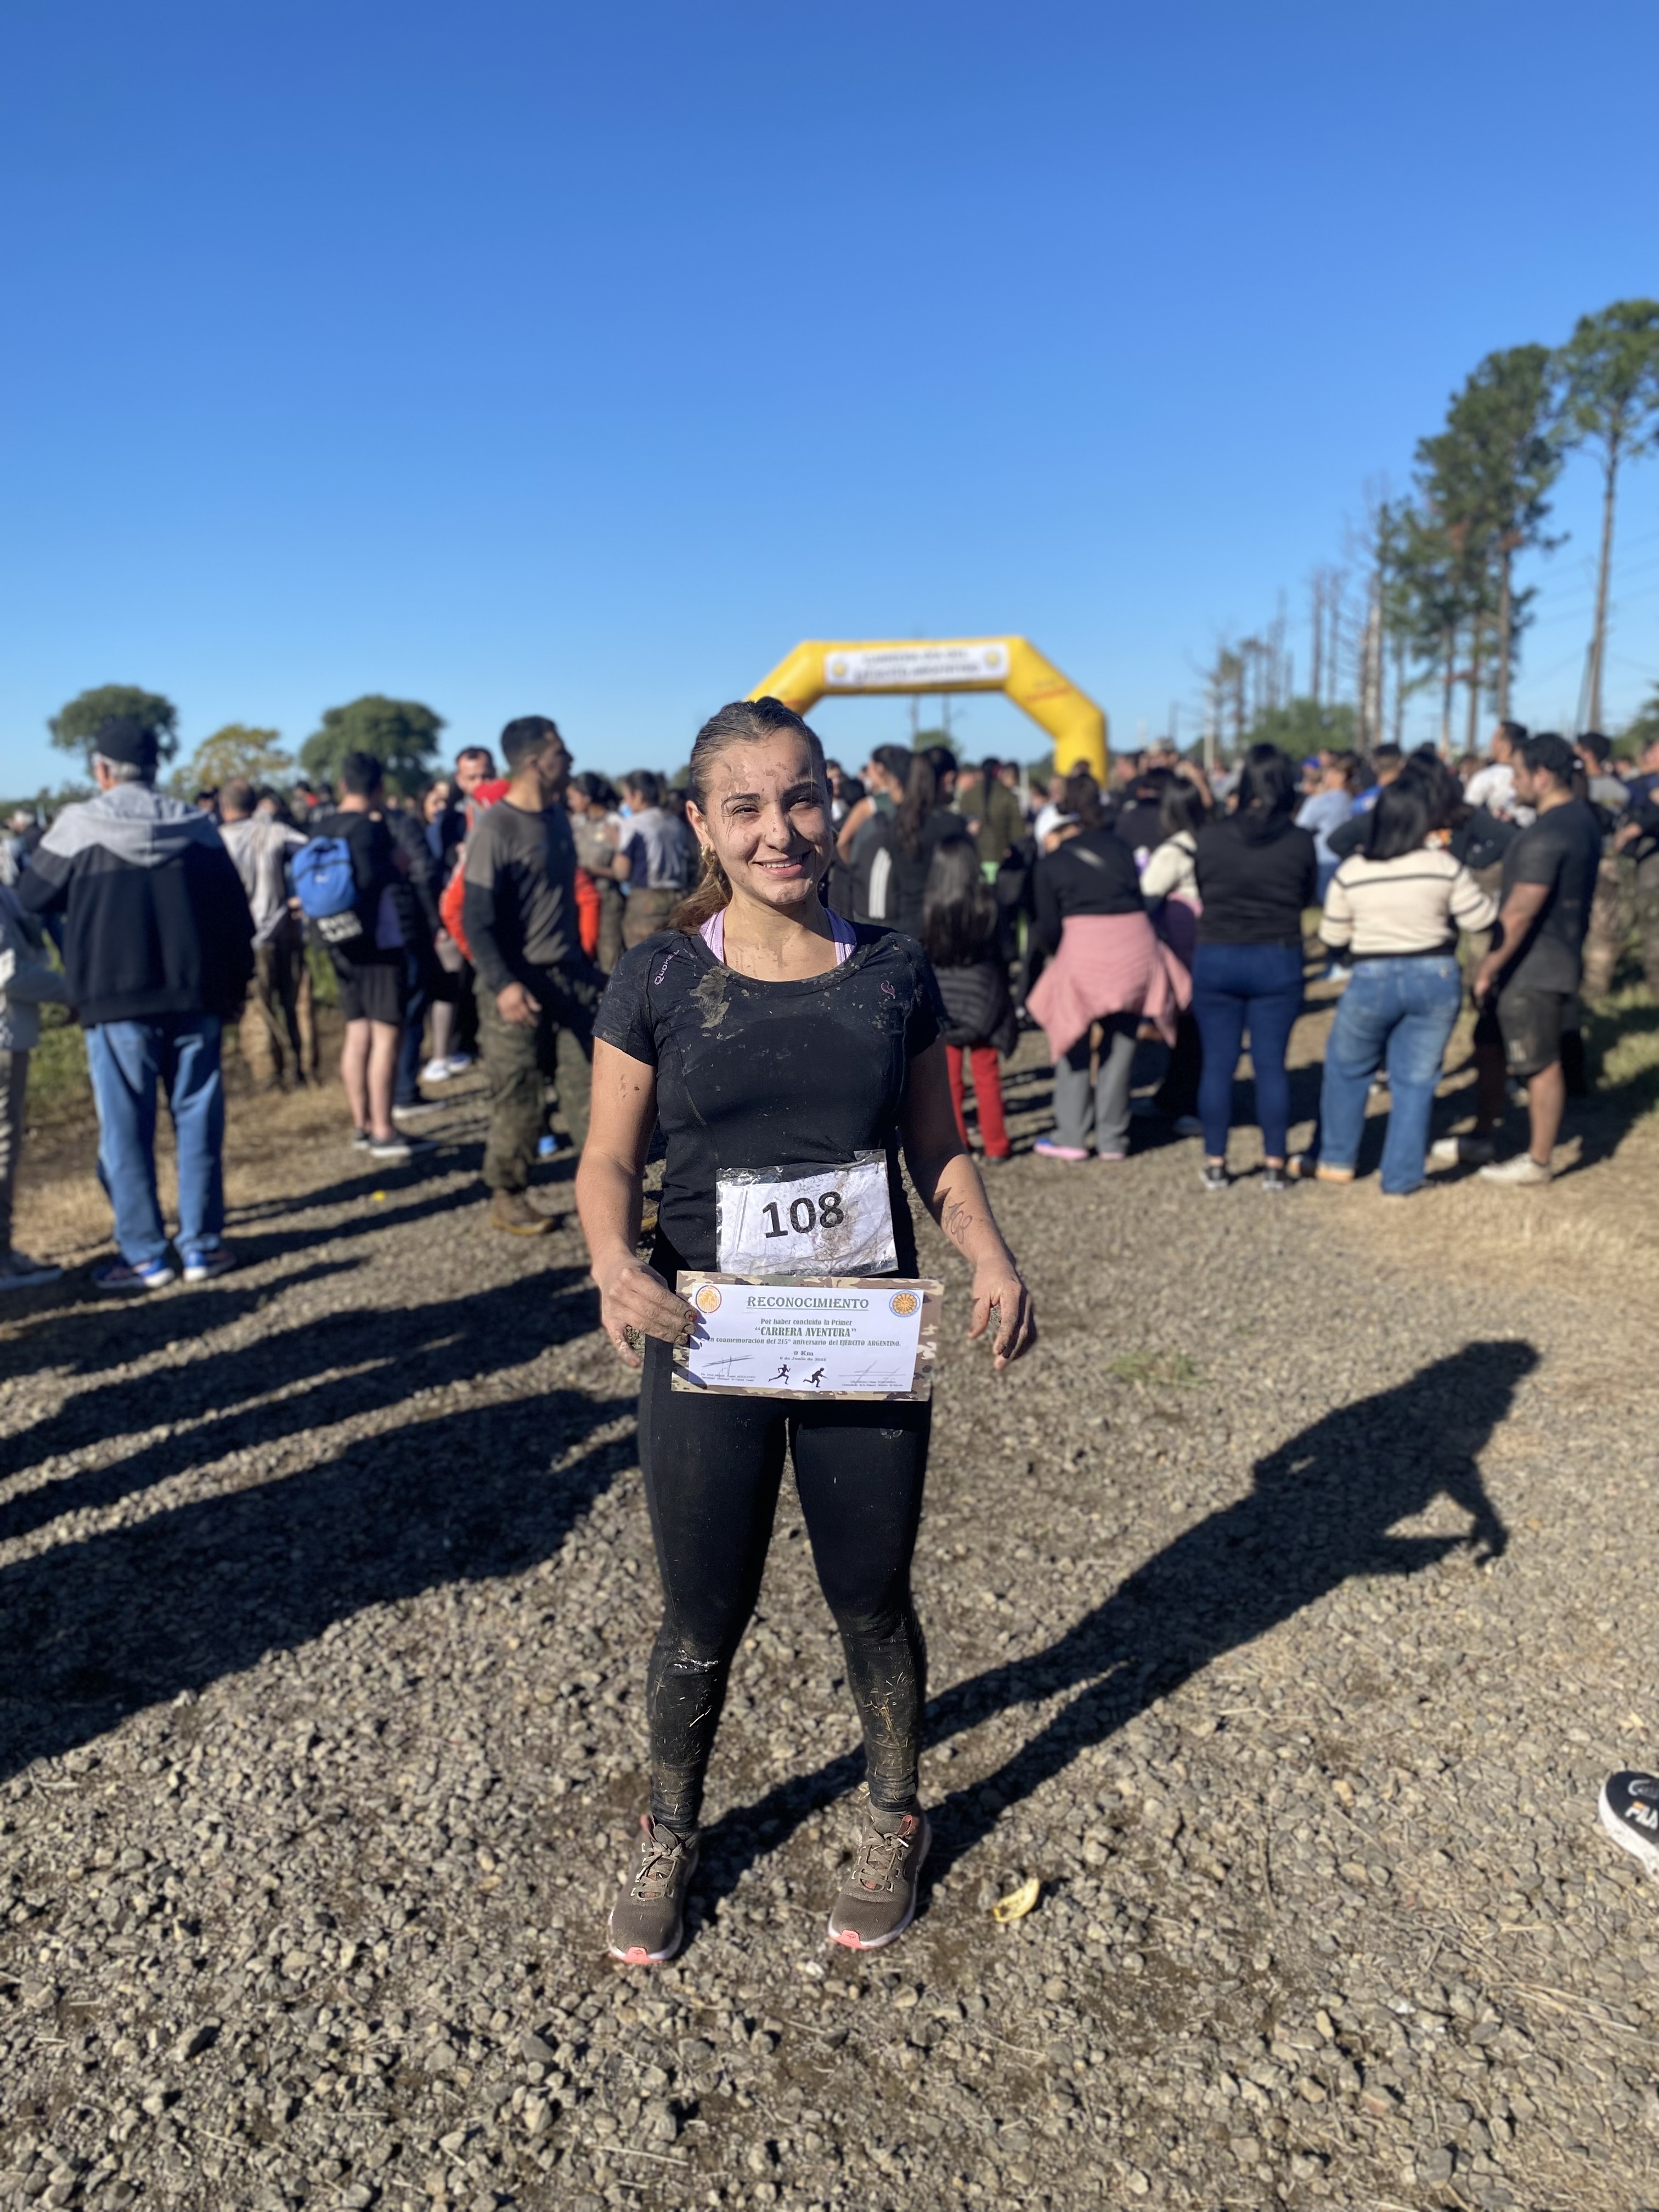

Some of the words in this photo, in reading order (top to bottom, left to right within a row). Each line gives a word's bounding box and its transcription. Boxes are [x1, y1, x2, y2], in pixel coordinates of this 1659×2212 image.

[763, 1191, 844, 1238] 108
[747, 1296, 869, 1308] RECONOCIMIENTO
[1625, 1805, 1658, 1830] FILA
